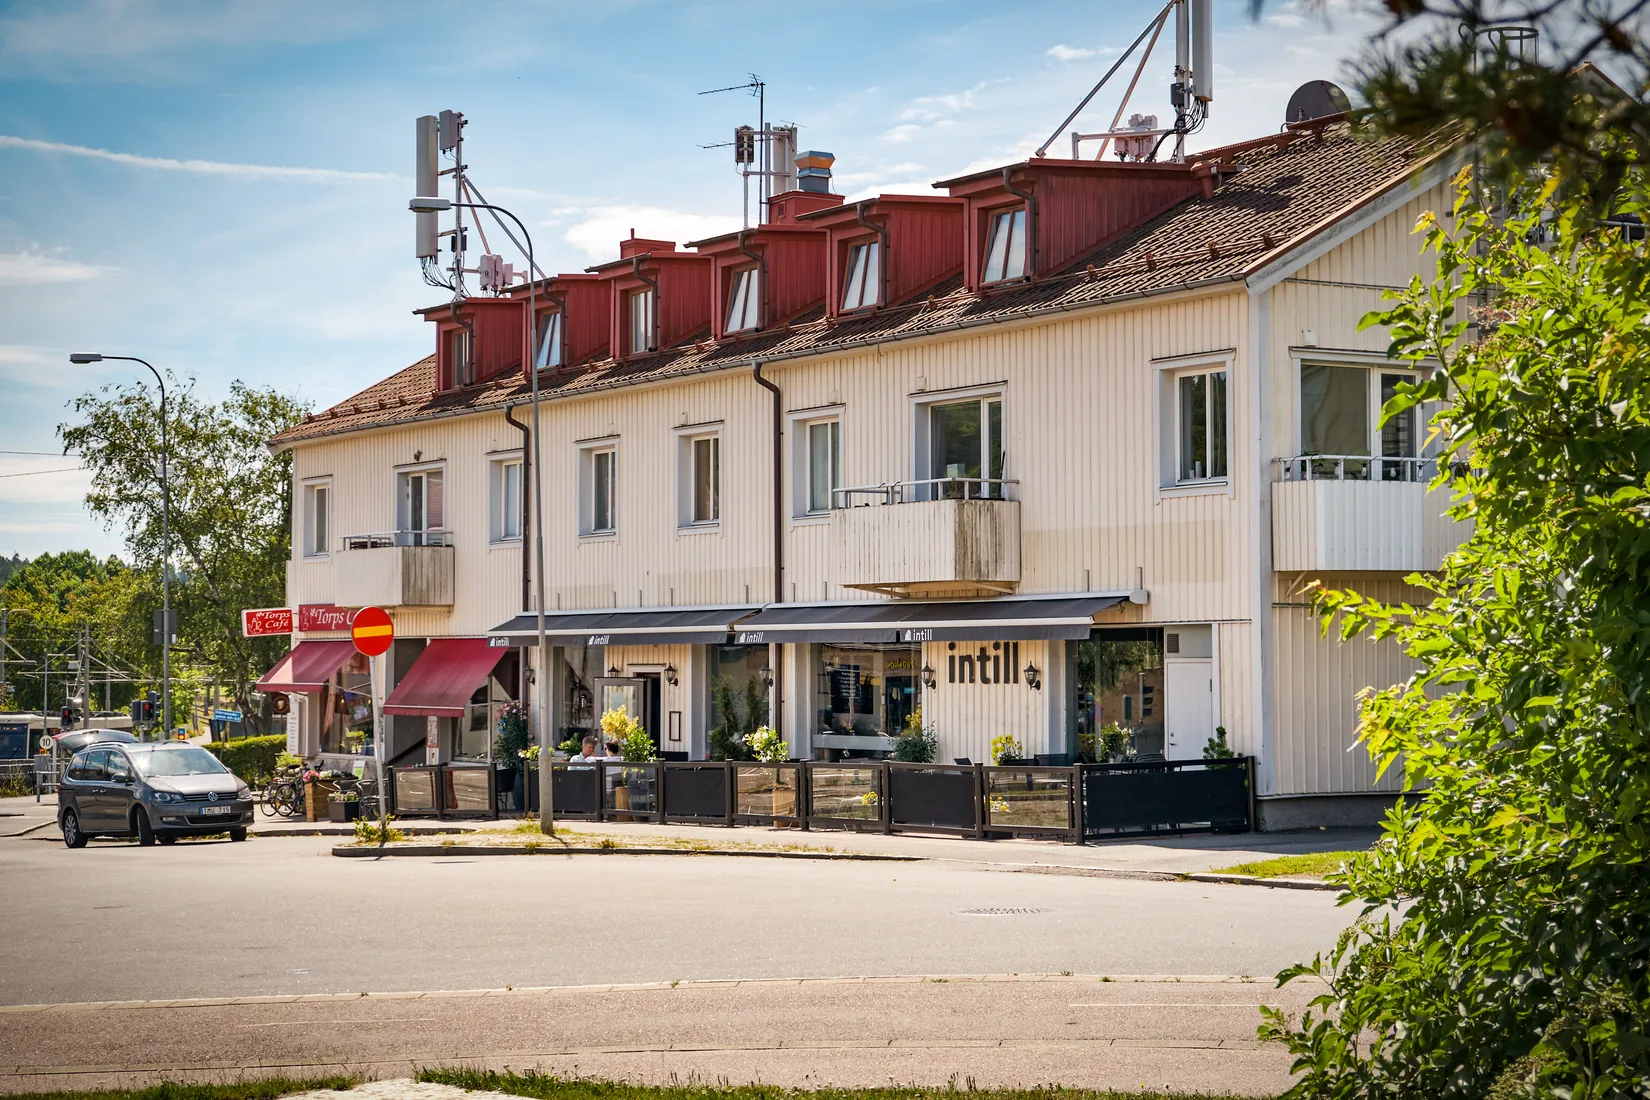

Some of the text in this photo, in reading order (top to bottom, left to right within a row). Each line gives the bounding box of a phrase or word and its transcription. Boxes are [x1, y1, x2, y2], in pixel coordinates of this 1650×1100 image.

[262, 611, 290, 620] Torps
[315, 608, 345, 630] Torps
[265, 619, 289, 630] Café
[594, 635, 610, 645] intill
[746, 632, 764, 643] intill
[913, 629, 932, 641] intill
[495, 637, 510, 647] intill
[948, 641, 1019, 685] intill
[41, 738, 51, 747] 10
[218, 805, 230, 813] 715
